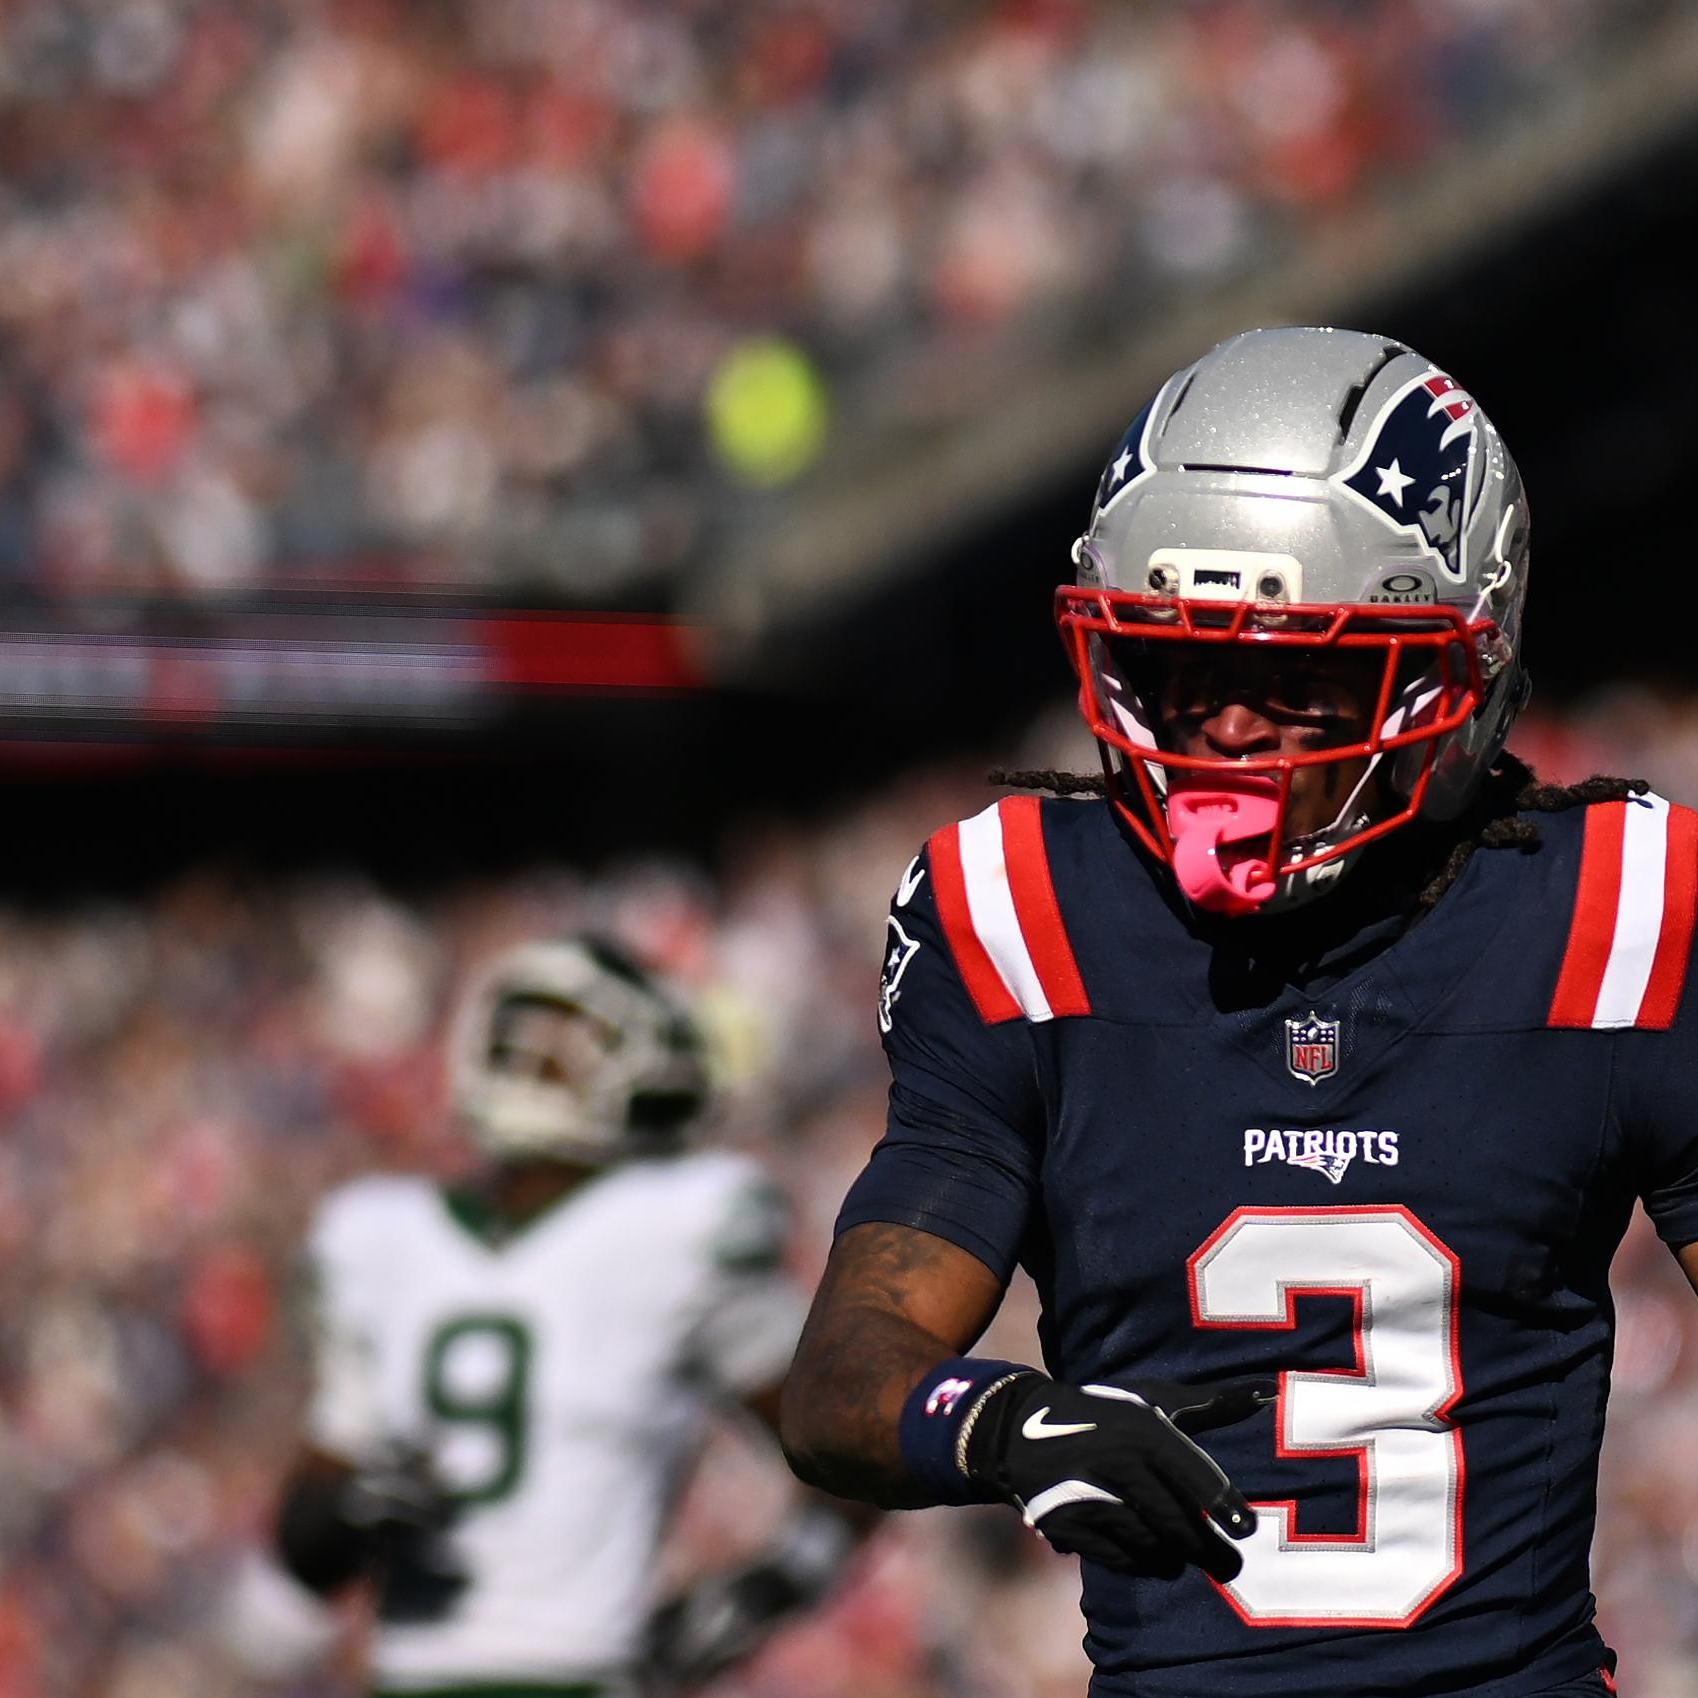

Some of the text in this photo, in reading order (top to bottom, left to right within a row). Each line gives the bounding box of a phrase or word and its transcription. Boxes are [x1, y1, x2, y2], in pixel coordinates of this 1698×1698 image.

[1294, 1044, 1332, 1072] NFL
[1243, 1129, 1400, 1167] PATRIOTS
[421, 1311, 535, 1507] 9
[1186, 1204, 1465, 1629] 3
